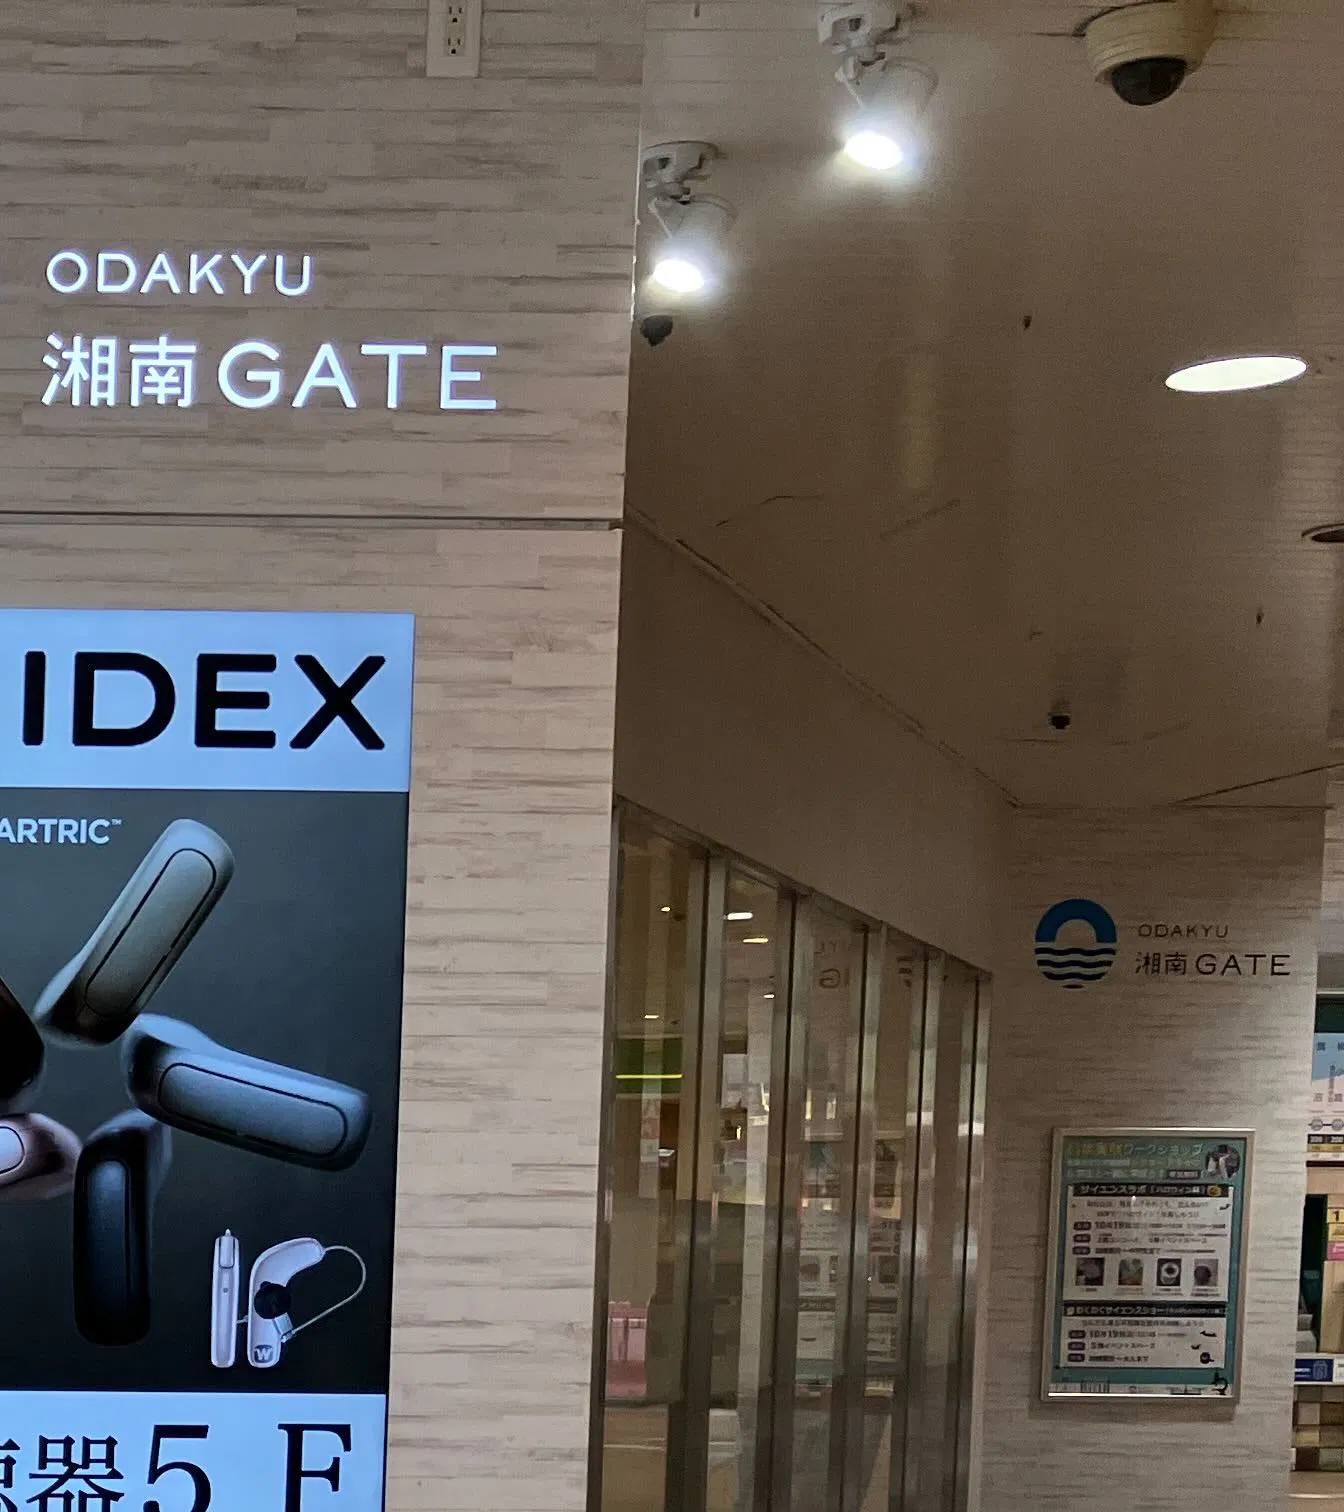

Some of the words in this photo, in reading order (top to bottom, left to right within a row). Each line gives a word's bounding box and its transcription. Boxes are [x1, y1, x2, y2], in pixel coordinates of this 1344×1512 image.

[45, 251, 314, 297] ODAKYU
[40, 331, 195, 409] 湘南
[216, 341, 500, 411] GATE
[1137, 922, 1229, 939] ODAKYU
[1195, 953, 1292, 978] GATE
